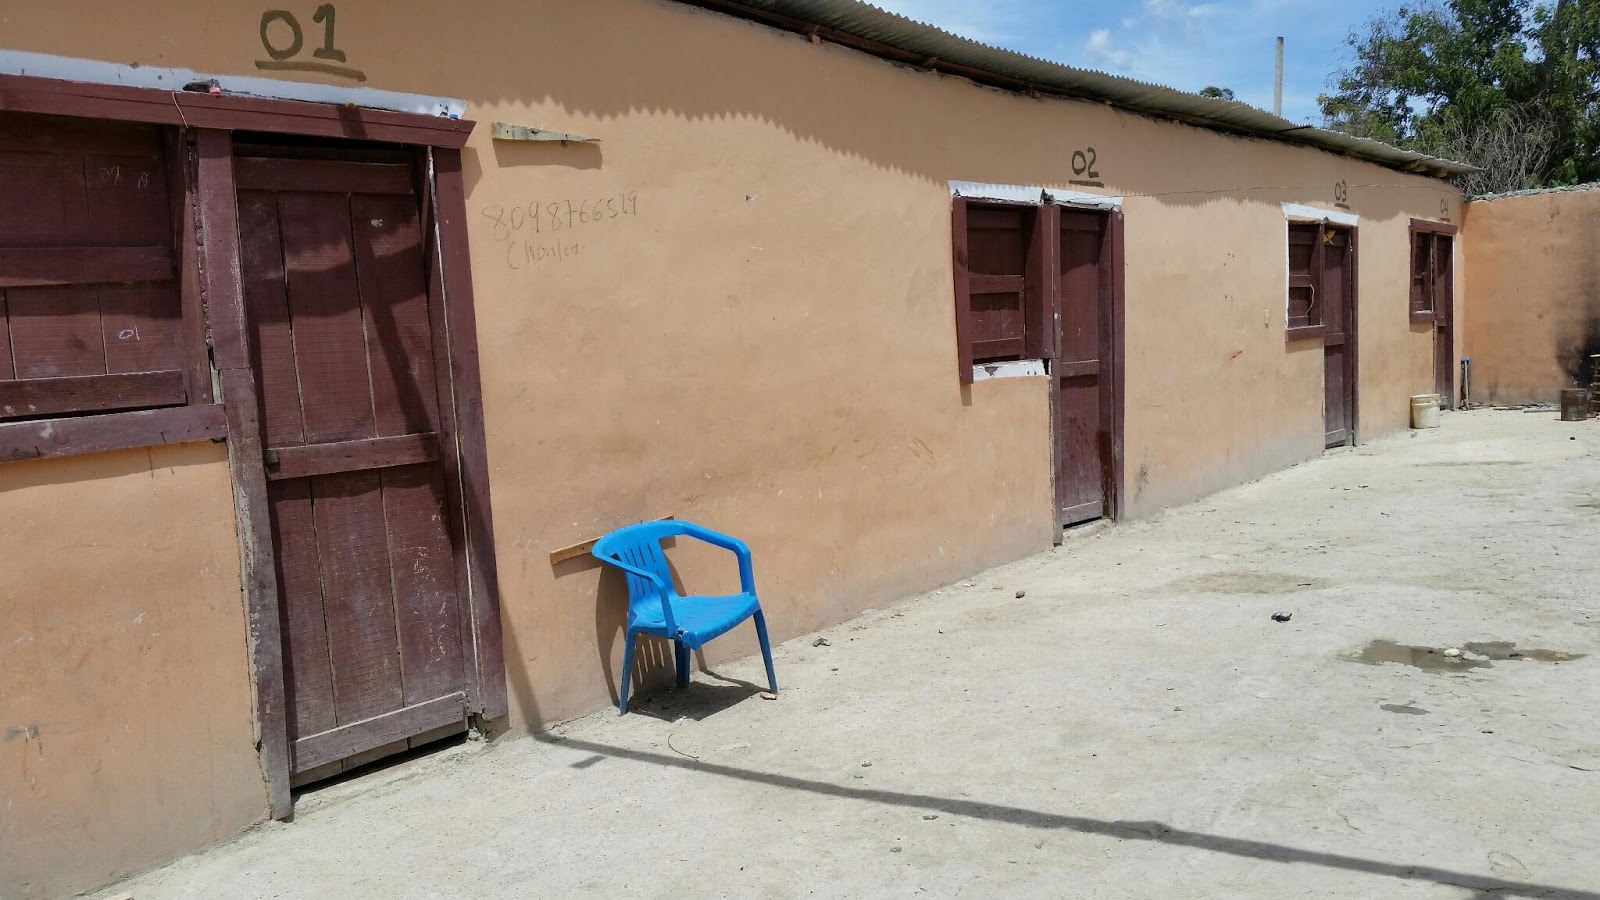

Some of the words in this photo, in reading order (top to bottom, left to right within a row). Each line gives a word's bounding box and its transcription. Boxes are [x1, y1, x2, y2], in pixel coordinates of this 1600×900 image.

[259, 3, 347, 63] 01
[1071, 146, 1100, 179] 02
[1334, 179, 1348, 203] 03
